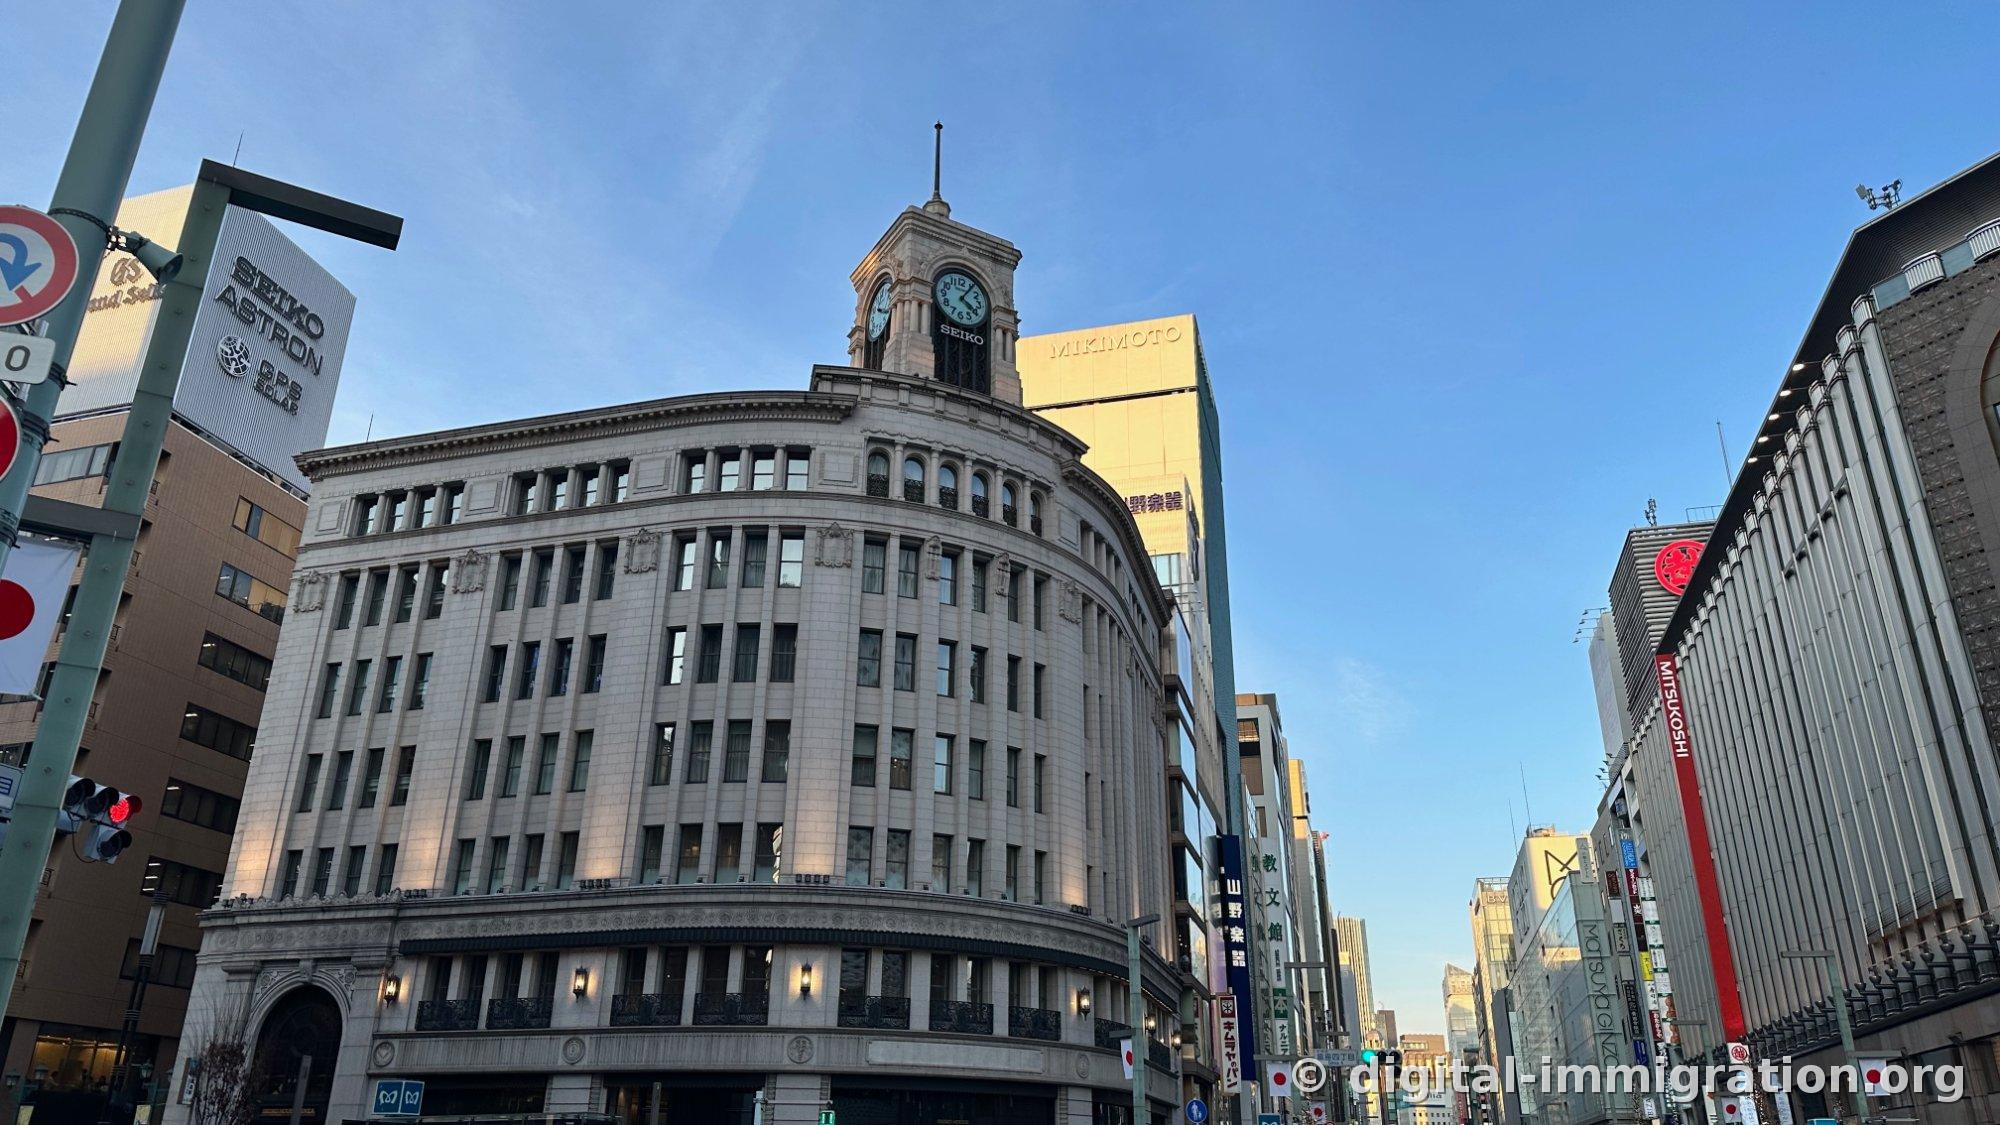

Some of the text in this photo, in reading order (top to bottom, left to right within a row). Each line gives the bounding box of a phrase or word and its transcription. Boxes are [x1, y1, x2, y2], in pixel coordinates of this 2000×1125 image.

[215, 284, 323, 376] ASTRON
[231, 256, 324, 340] SEIKO
[940, 324, 984, 346] SEIKO
[1050, 326, 1182, 359] MIKIMOTO
[253, 375, 299, 416] SOLAR
[259, 359, 303, 400] GPS
[1125, 491, 1184, 515] 野楽器
[1659, 661, 1689, 758] MITSUKOSHI
[1227, 878, 1246, 967] 山野楽器
[1262, 853, 1283, 942] 教文館
[1223, 1021, 1239, 1089] キムラヤのパン
